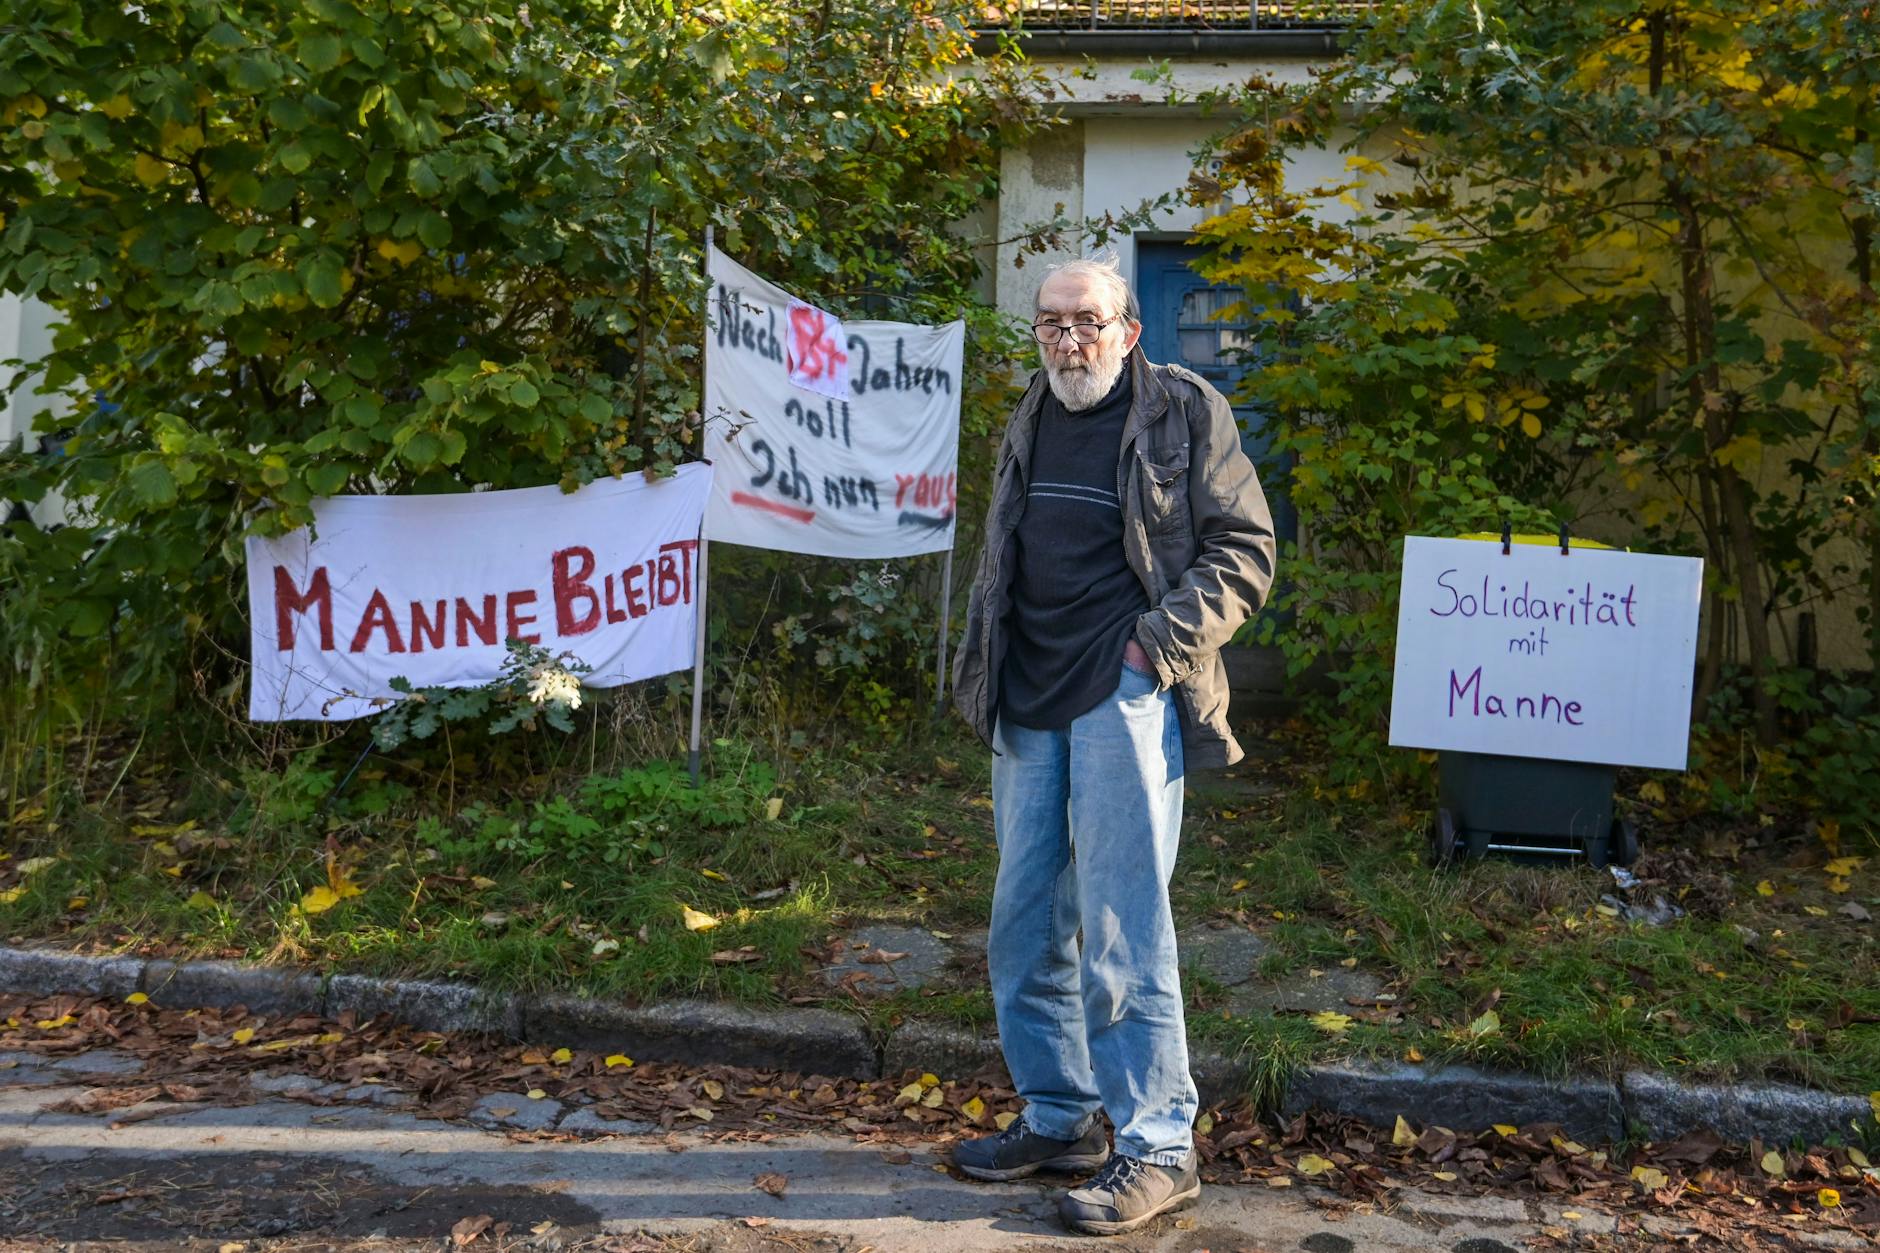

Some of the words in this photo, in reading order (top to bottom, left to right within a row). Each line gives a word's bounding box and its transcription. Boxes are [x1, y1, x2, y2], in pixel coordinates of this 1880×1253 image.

[847, 335, 951, 395] Jahren
[824, 475, 879, 512] nun
[274, 565, 541, 653] MANNE
[551, 539, 699, 637] BLEIBT
[1508, 626, 1550, 656] mit
[1448, 665, 1584, 726] Manne
